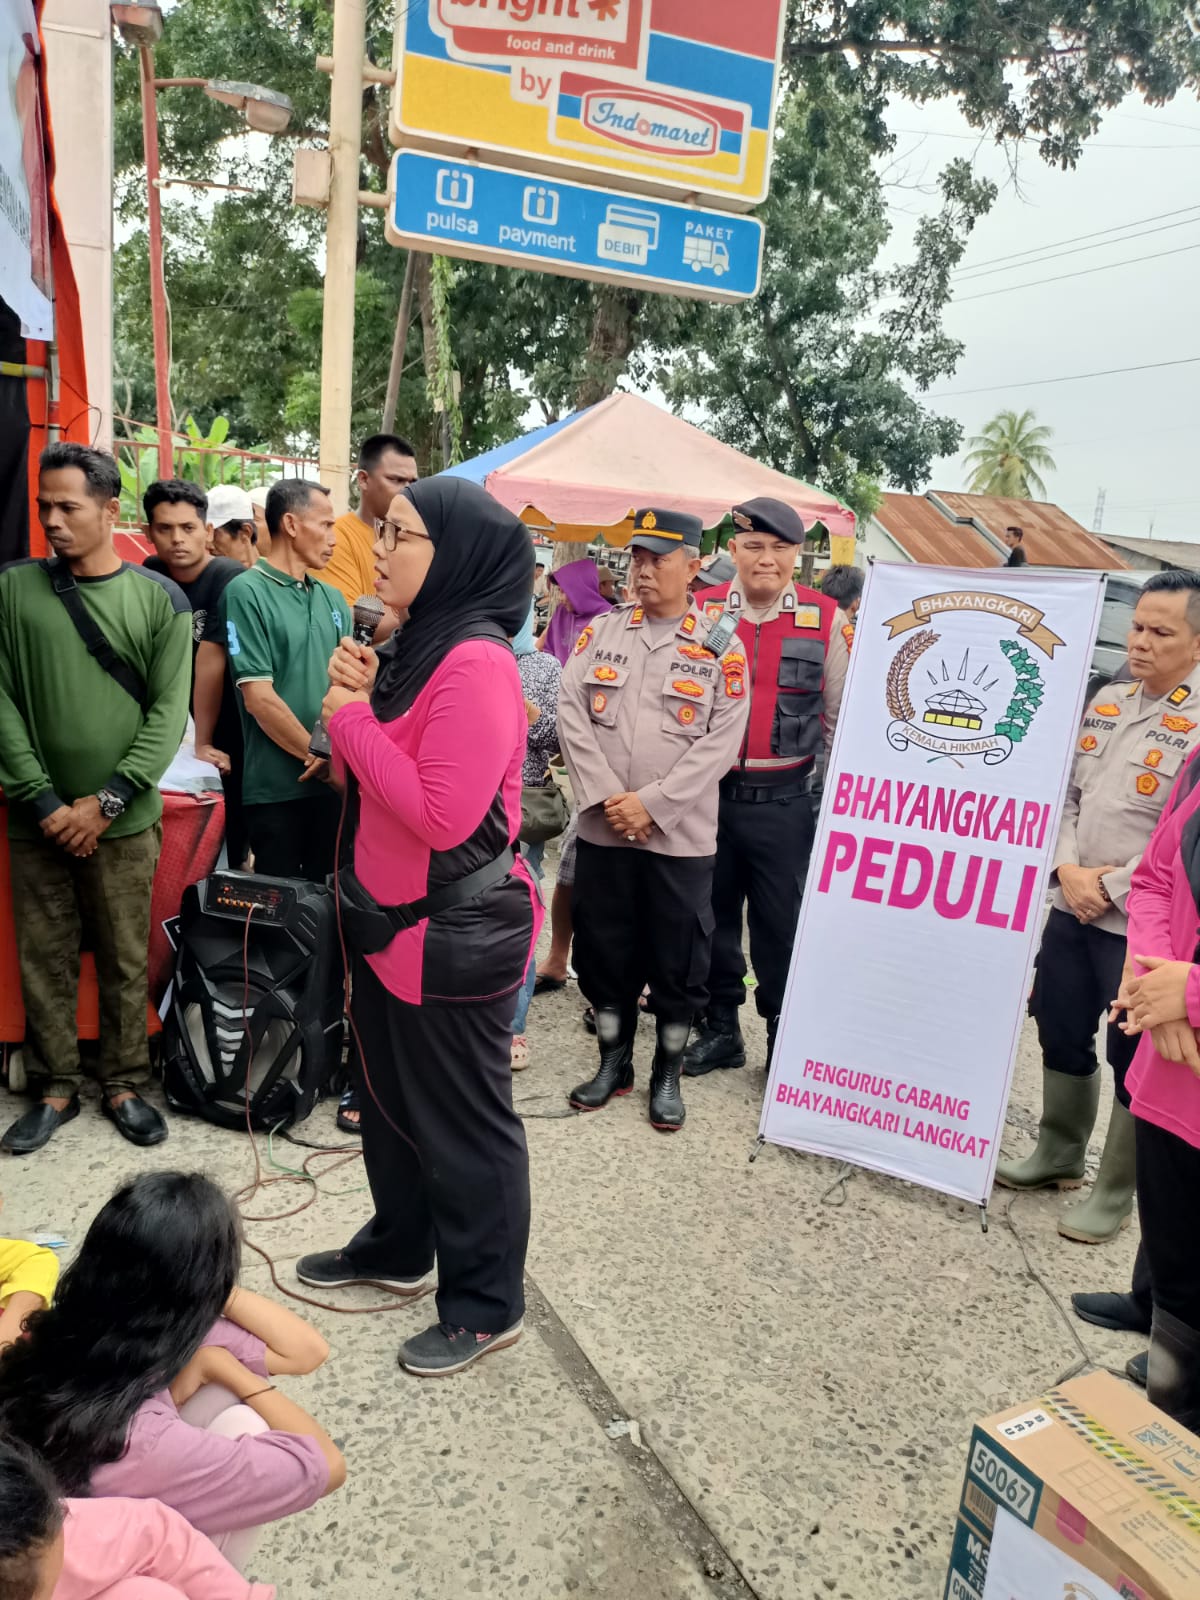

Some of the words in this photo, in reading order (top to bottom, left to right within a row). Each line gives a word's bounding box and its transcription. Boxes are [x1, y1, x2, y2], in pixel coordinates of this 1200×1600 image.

[506, 35, 541, 51] food
[545, 41, 574, 55] and
[578, 44, 616, 60] drink
[520, 66, 552, 99] by
[591, 101, 710, 147] Indomaret
[427, 209, 479, 235] pulsa
[684, 221, 734, 241] PAKET
[499, 223, 577, 253] payment
[604, 238, 642, 257] DEBIT
[919, 595, 1036, 624] BHAYANGKARI
[594, 649, 629, 665] HARI
[670, 661, 714, 678] POLRI
[901, 725, 947, 752] KEMALA
[949, 737, 999, 753] HIKMAH
[1145, 729, 1190, 749] POLRI
[831, 772, 1052, 849] BHAYANGKARI
[817, 830, 1039, 933] PEDULI
[802, 1058, 893, 1099] PENGURUS
[895, 1083, 971, 1121] CABANG
[775, 1083, 901, 1134] BHAYANGKARI
[903, 1117, 990, 1159] LANGKAT
[974, 1448, 1032, 1509] 50067
